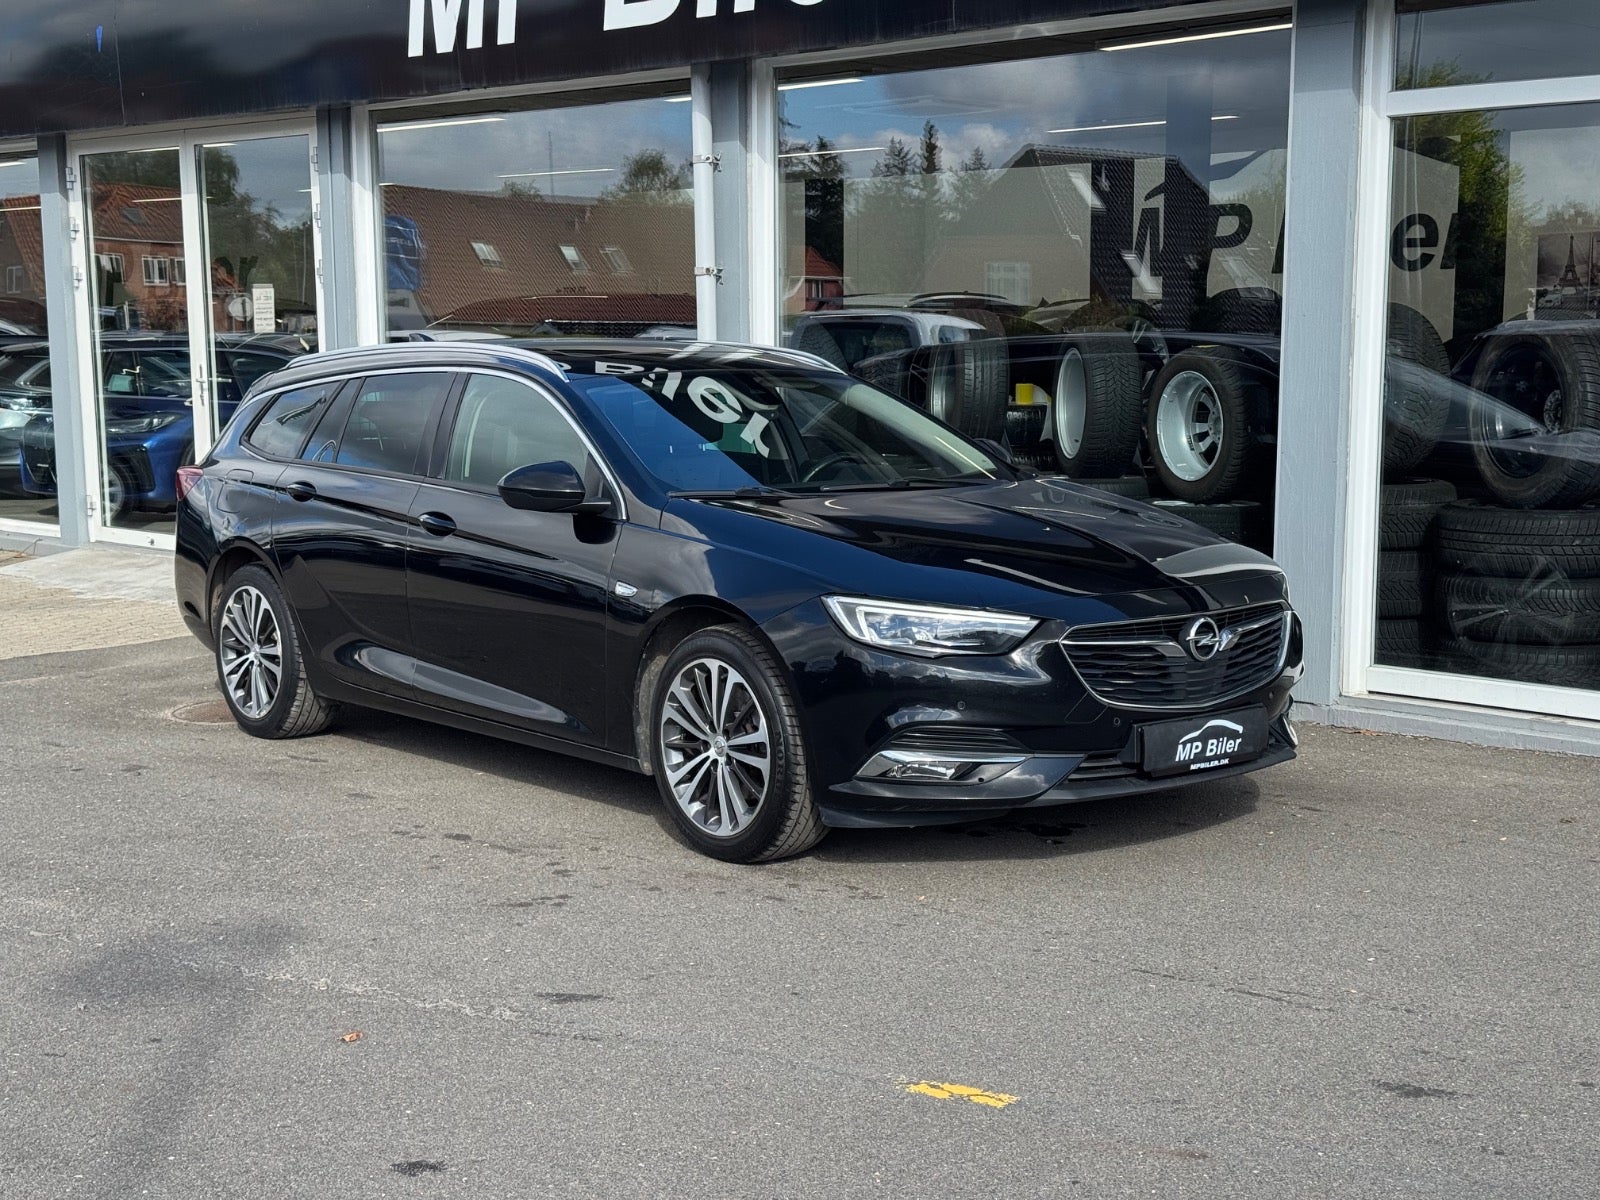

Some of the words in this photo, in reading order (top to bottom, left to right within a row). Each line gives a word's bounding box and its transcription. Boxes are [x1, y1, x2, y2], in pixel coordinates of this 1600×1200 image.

[1175, 741, 1203, 762] MP
[1205, 737, 1242, 757] Biler
[1190, 758, 1230, 770] MPBILER.DK
